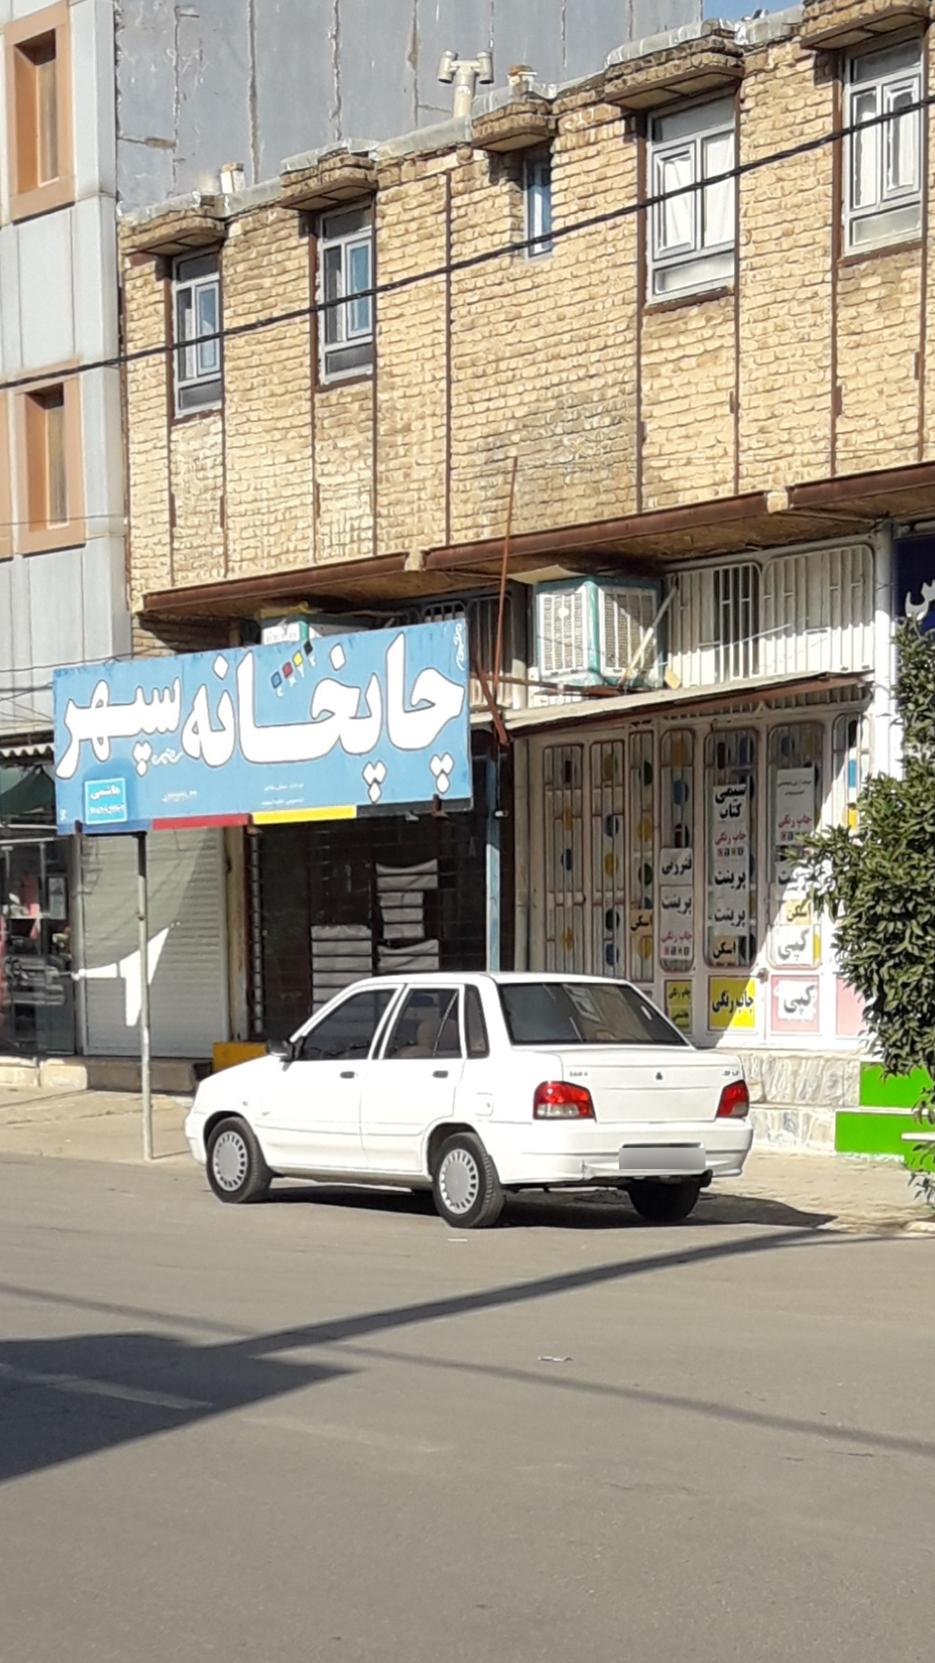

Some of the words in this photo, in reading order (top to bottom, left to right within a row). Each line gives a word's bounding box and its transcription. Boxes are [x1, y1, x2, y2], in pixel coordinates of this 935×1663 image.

[55, 675, 182, 777] سپهر
[181, 632, 467, 803] چاپخانه
[719, 802, 742, 823] کتاب
[714, 869, 746, 890] پرینت
[661, 894, 692, 915] پرینت
[630, 914, 653, 931] اسکن
[714, 907, 746, 928] پرینت
[713, 941, 736, 959] اسکن
[778, 928, 809, 961] کپی
[711, 990, 736, 1014] رنگی
[735, 990, 754, 1014] چاپ
[783, 985, 816, 1014] کپی
